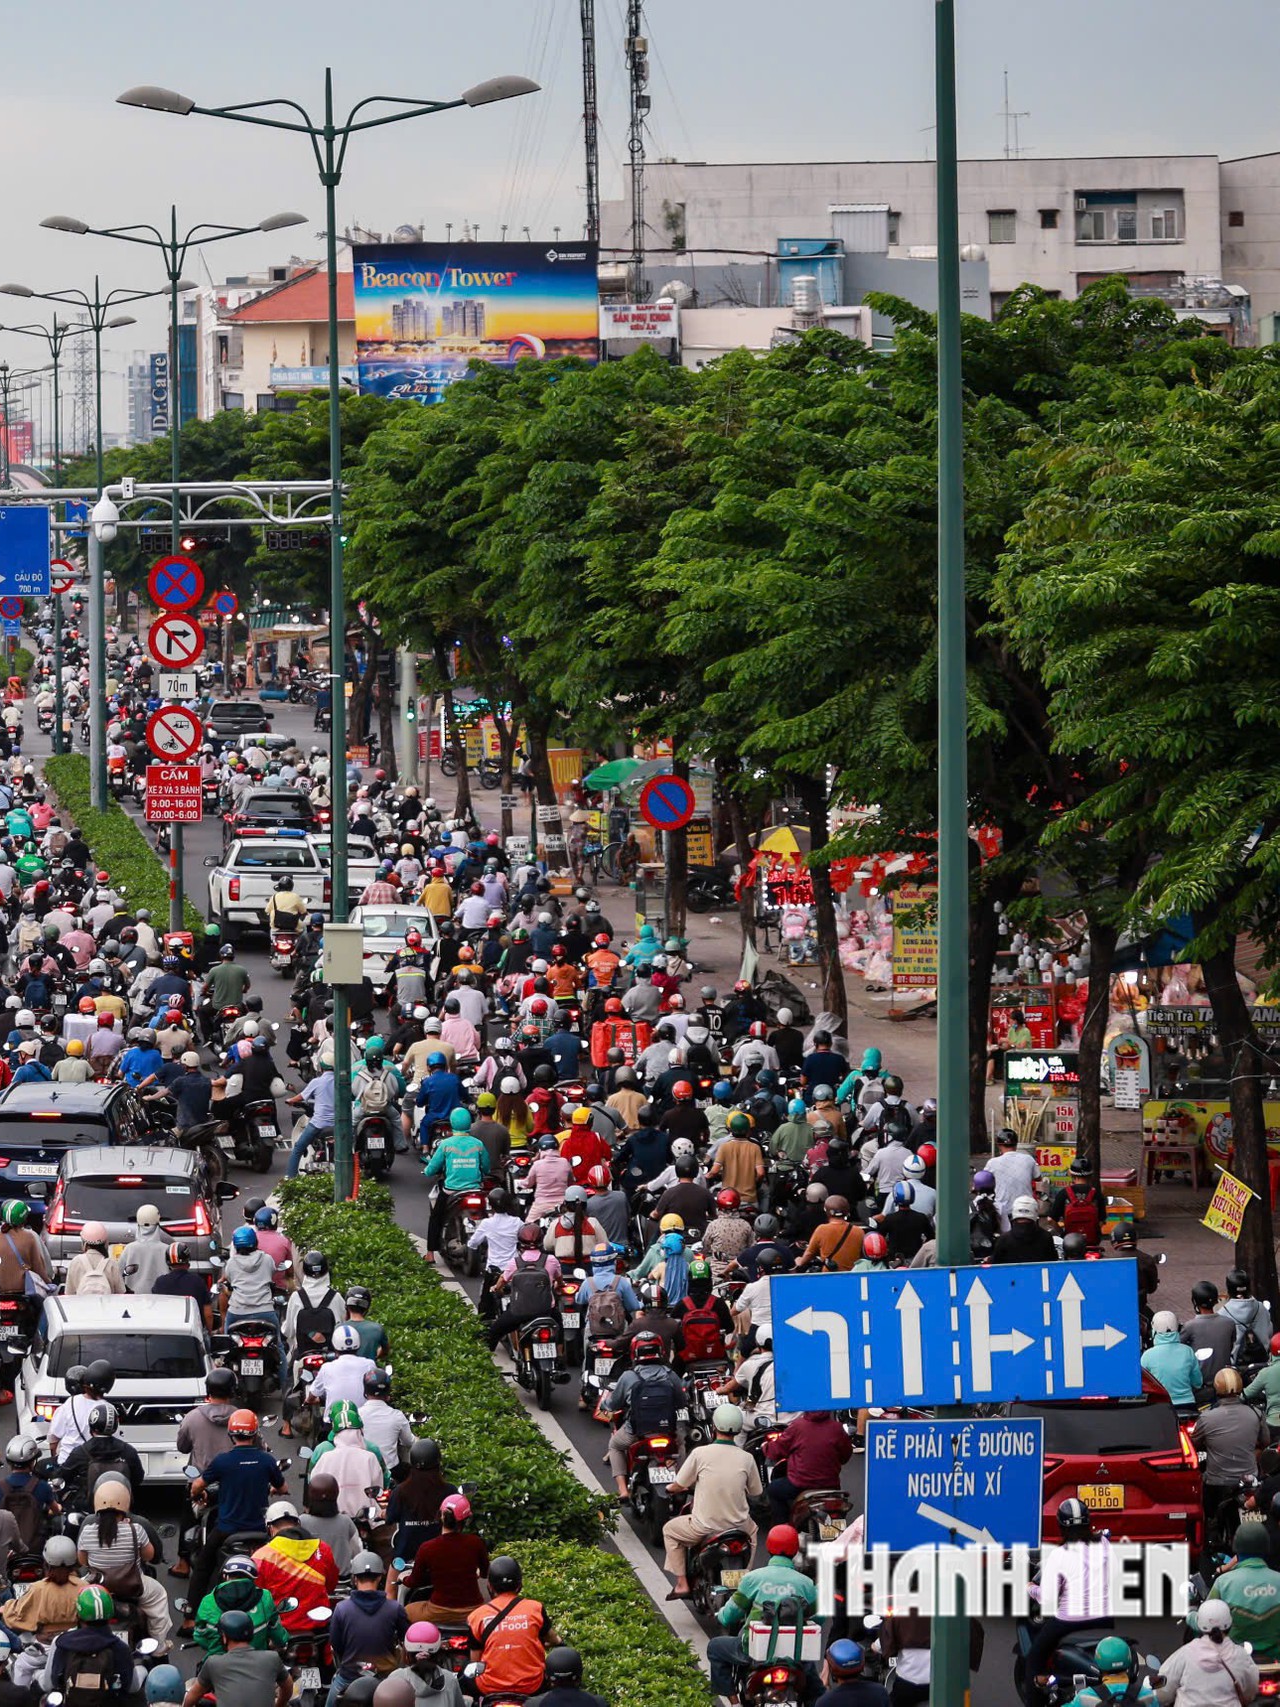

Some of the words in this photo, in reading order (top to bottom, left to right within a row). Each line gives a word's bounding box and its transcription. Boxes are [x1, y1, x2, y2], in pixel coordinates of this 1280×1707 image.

[362, 263, 440, 288] Beacon
[446, 267, 518, 287] Tower
[151, 354, 167, 429] Dr.Care
[19, 585, 32, 593] 700
[160, 767, 189, 780] CẤM
[148, 786, 158, 794] XE
[158, 786, 163, 794] 2
[164, 784, 173, 794] VÀ
[174, 786, 179, 794] 3
[180, 783, 201, 794] BÁNH
[151, 800, 198, 808] 9:00-16:00
[150, 810, 198, 819] 20:00-6:00
[708, 1014, 722, 1030] 10
[1055, 1105, 1075, 1117] 15k
[1055, 1121, 1074, 1133] 10k
[1220, 1221, 1239, 1237] 10K
[875, 1429, 897, 1459] RẼ
[904, 1427, 942, 1458] PHẢI
[951, 1424, 974, 1458] VỀ
[978, 1426, 1034, 1456] ĐƯỜNG
[907, 1461, 975, 1497] NGUYỄN
[984, 1465, 1003, 1496] XÍ
[1092, 1487, 1111, 1497] 18G
[1083, 1498, 1119, 1508] 001.00
[1243, 1585, 1277, 1597] Grab
[503, 1613, 528, 1622] hopee
[501, 1620, 528, 1631] Food
